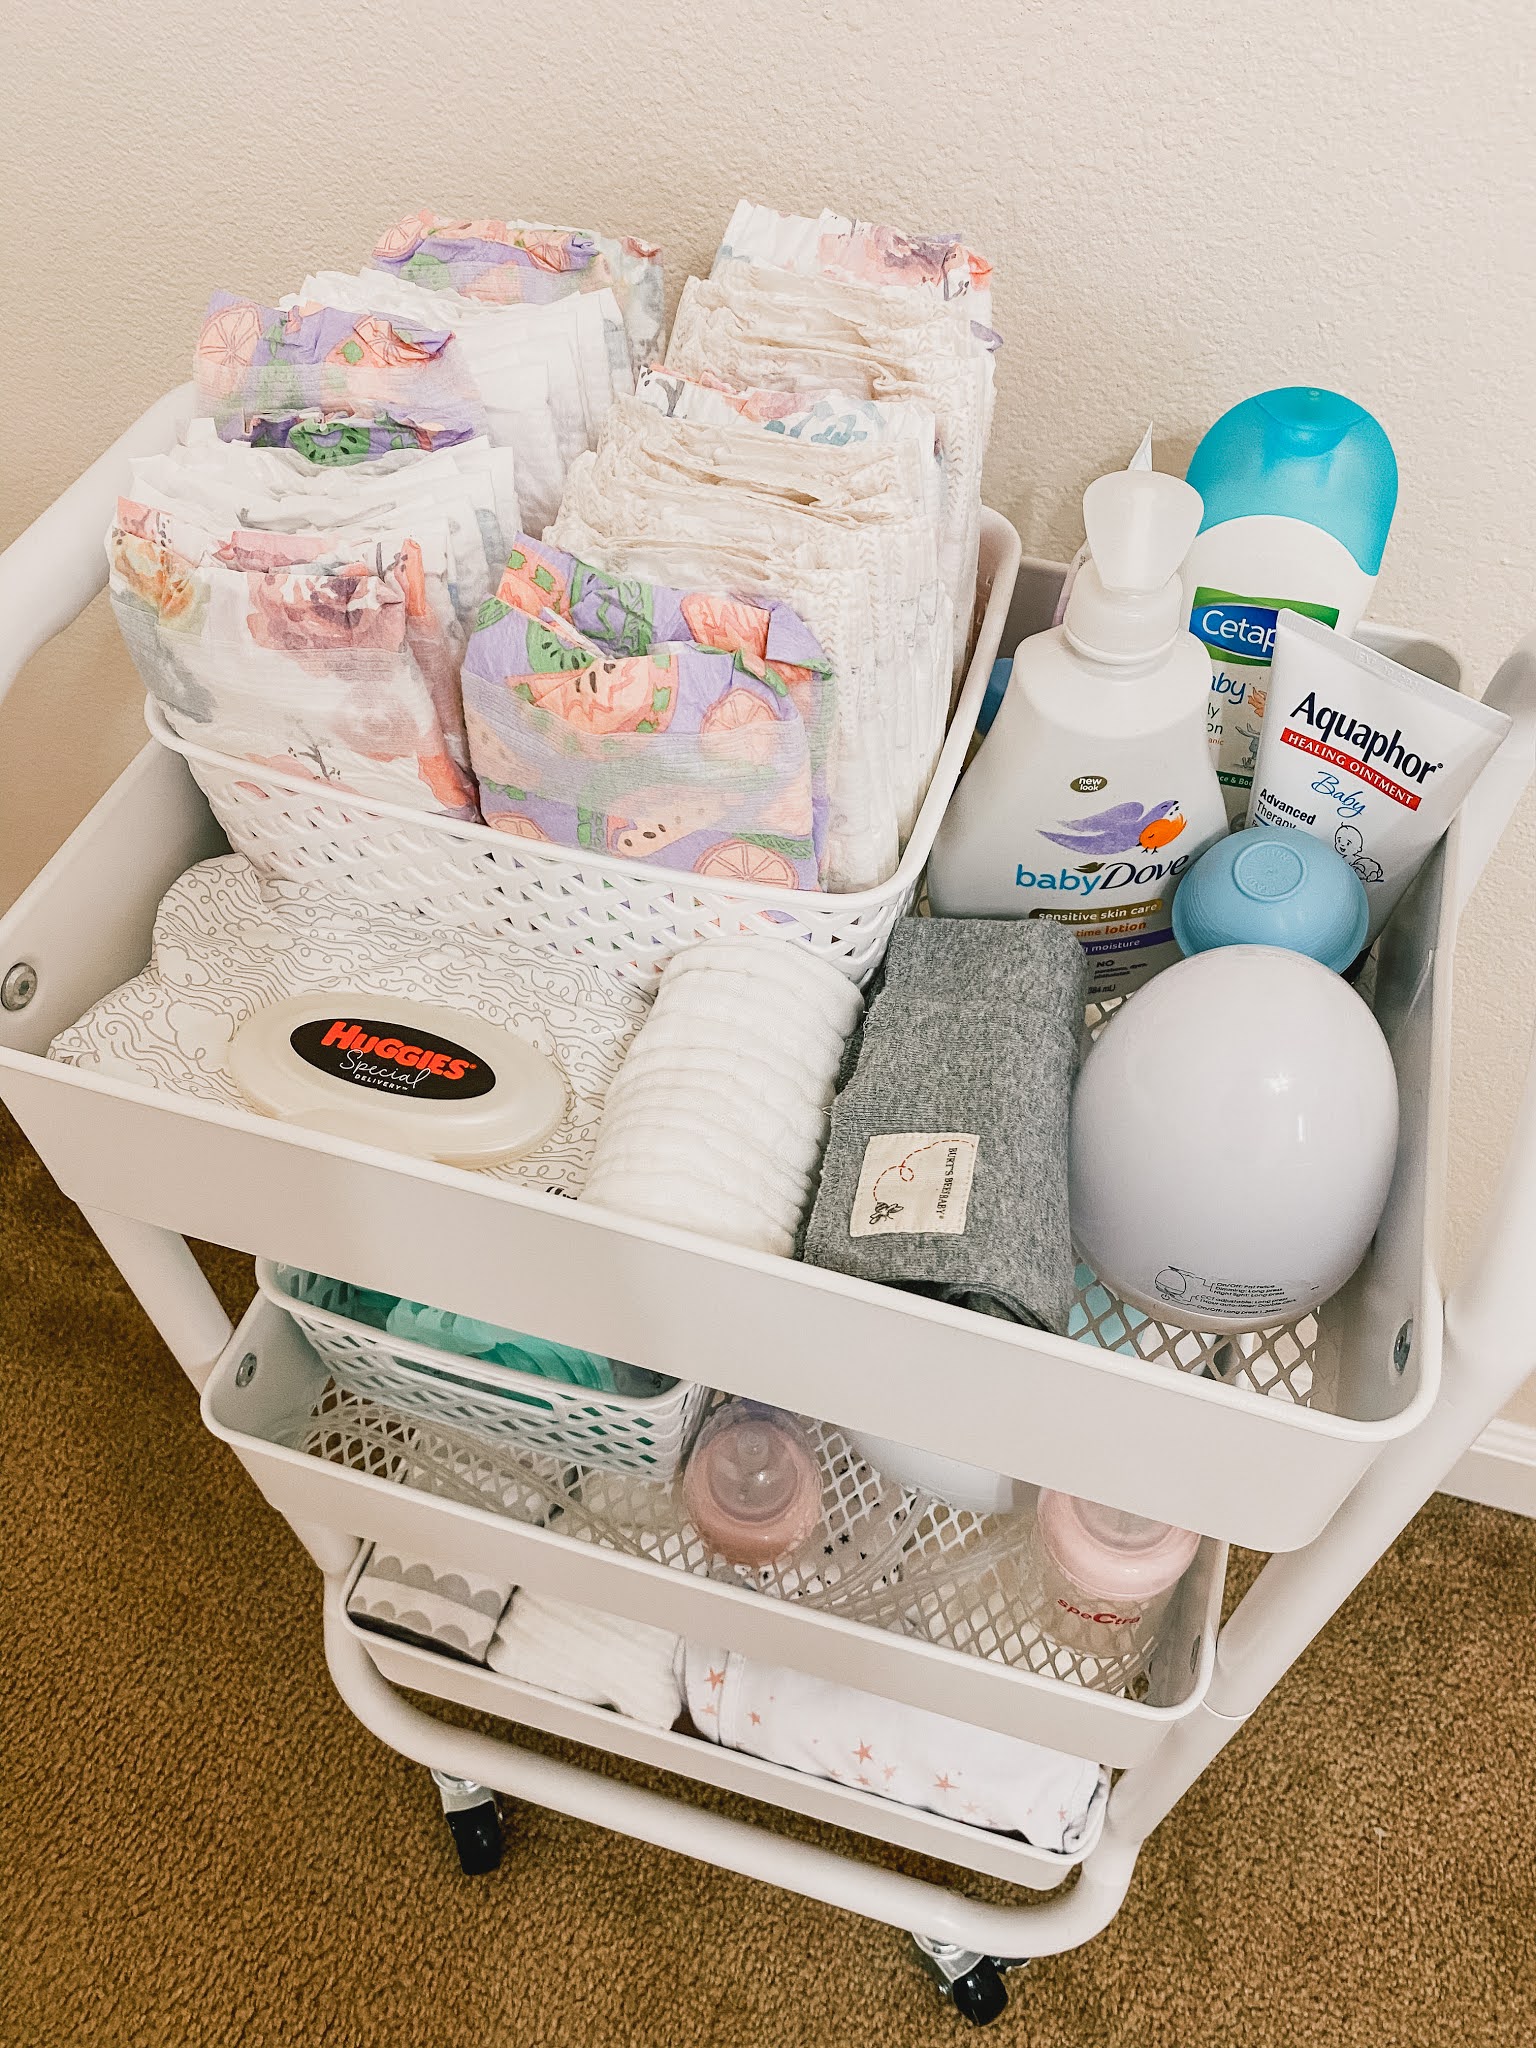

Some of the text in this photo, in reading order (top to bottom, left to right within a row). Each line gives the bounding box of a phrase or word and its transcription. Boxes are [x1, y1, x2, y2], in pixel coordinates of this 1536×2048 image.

[1290, 691, 1437, 784] Aquaphor
[1079, 777, 1103, 785] new
[1288, 733, 1414, 805] HEALING OINTMENT
[1260, 788, 1316, 826] Advanced
[1311, 771, 1366, 818] Baby
[1038, 902, 1158, 921] sensitive skin care
[1105, 921, 1147, 935] lotion
[1092, 940, 1140, 952] moisture
[1096, 960, 1115, 968] NO
[339, 1049, 431, 1089] Special
